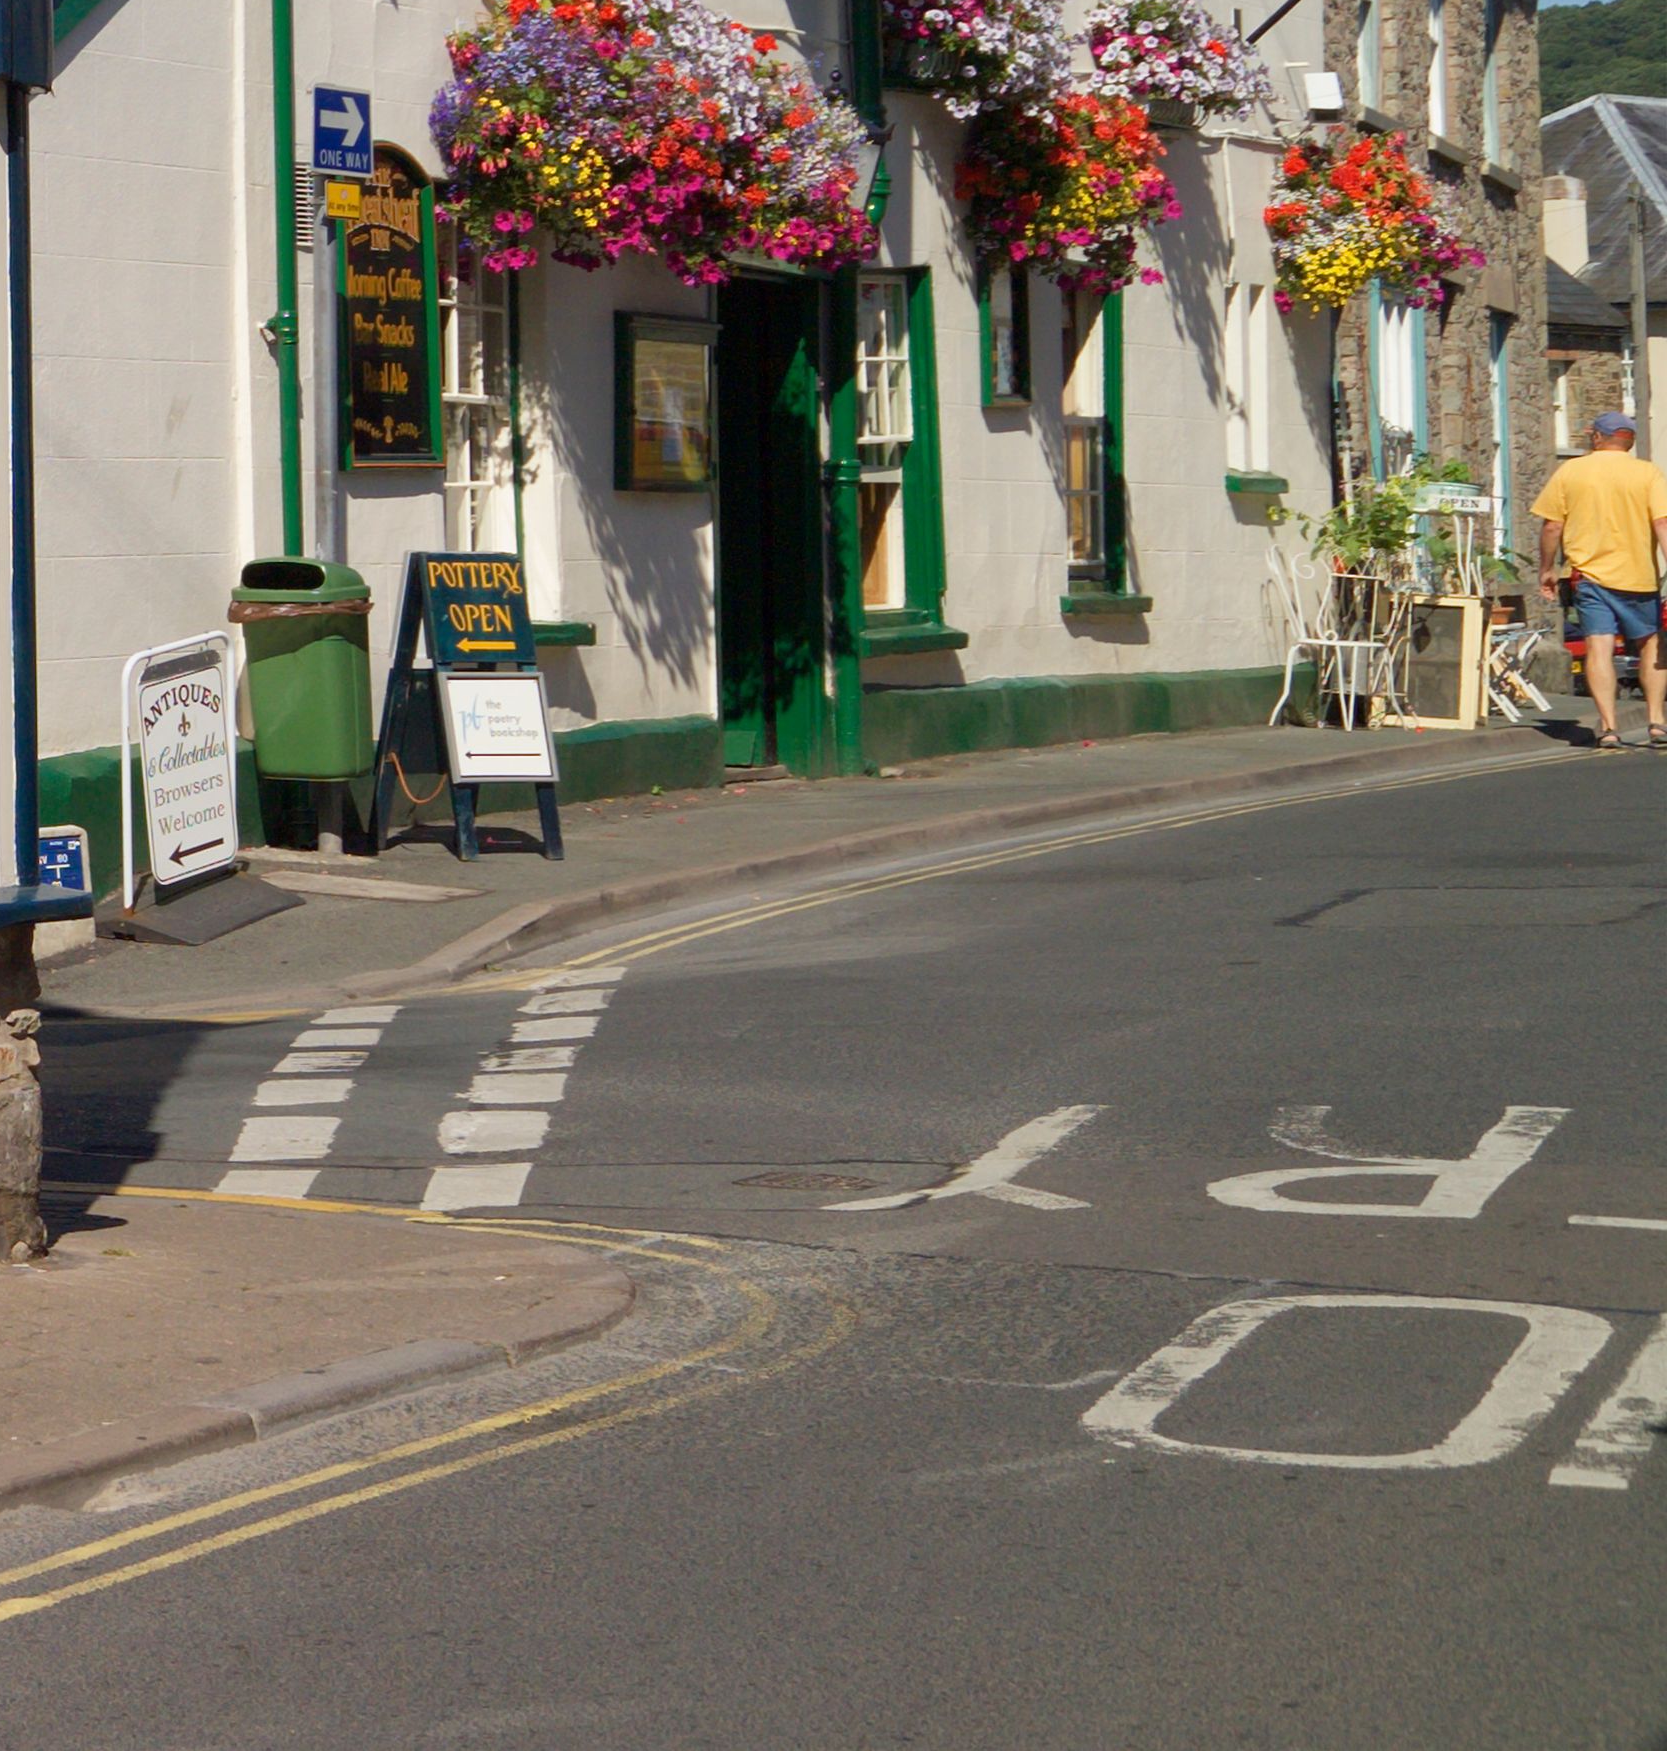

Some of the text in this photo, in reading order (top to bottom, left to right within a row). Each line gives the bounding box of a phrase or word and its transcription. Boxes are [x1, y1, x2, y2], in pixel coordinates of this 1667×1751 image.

[320, 149, 370, 170] ONE WAY
[387, 266, 423, 302] Coffee
[353, 312, 416, 348] Bar Snacks
[389, 361, 410, 395] Ale
[1439, 497, 1480, 509] OPEN
[426, 561, 524, 599] POTTERY
[448, 603, 514, 633] OPEN
[142, 683, 222, 737] ANTIQUES
[484, 699, 503, 710] the
[487, 713, 522, 727] poetry
[489, 726, 540, 741] bookshop
[158, 731, 227, 775] Collectables
[152, 773, 225, 810] Browsers
[157, 802, 226, 837] Welcome
